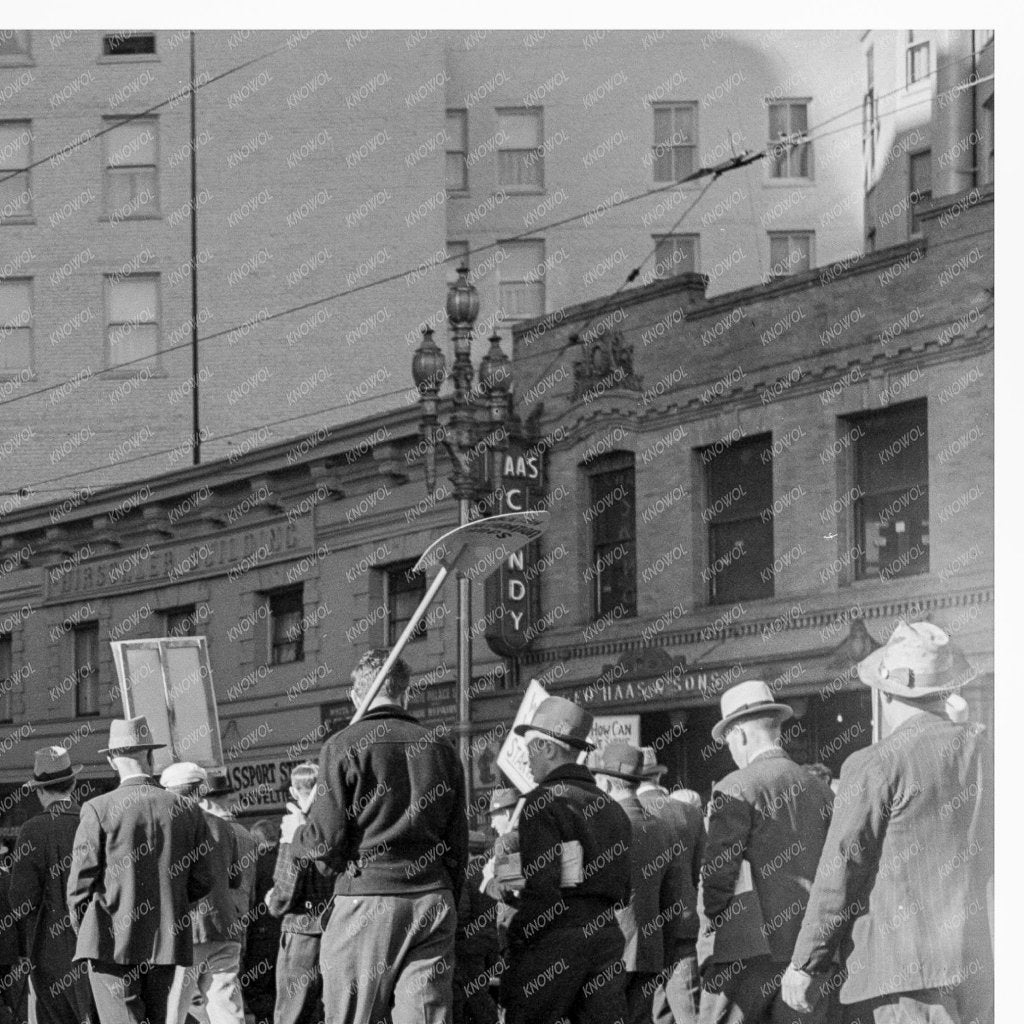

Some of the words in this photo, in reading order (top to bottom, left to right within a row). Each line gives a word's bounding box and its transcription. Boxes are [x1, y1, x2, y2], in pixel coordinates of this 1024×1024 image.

[503, 455, 539, 479] AAS
[506, 488, 527, 632] CNDY
[602, 680, 647, 703] HAAS
[672, 670, 722, 691] SONS
[238, 789, 293, 808] NOVELTIE
